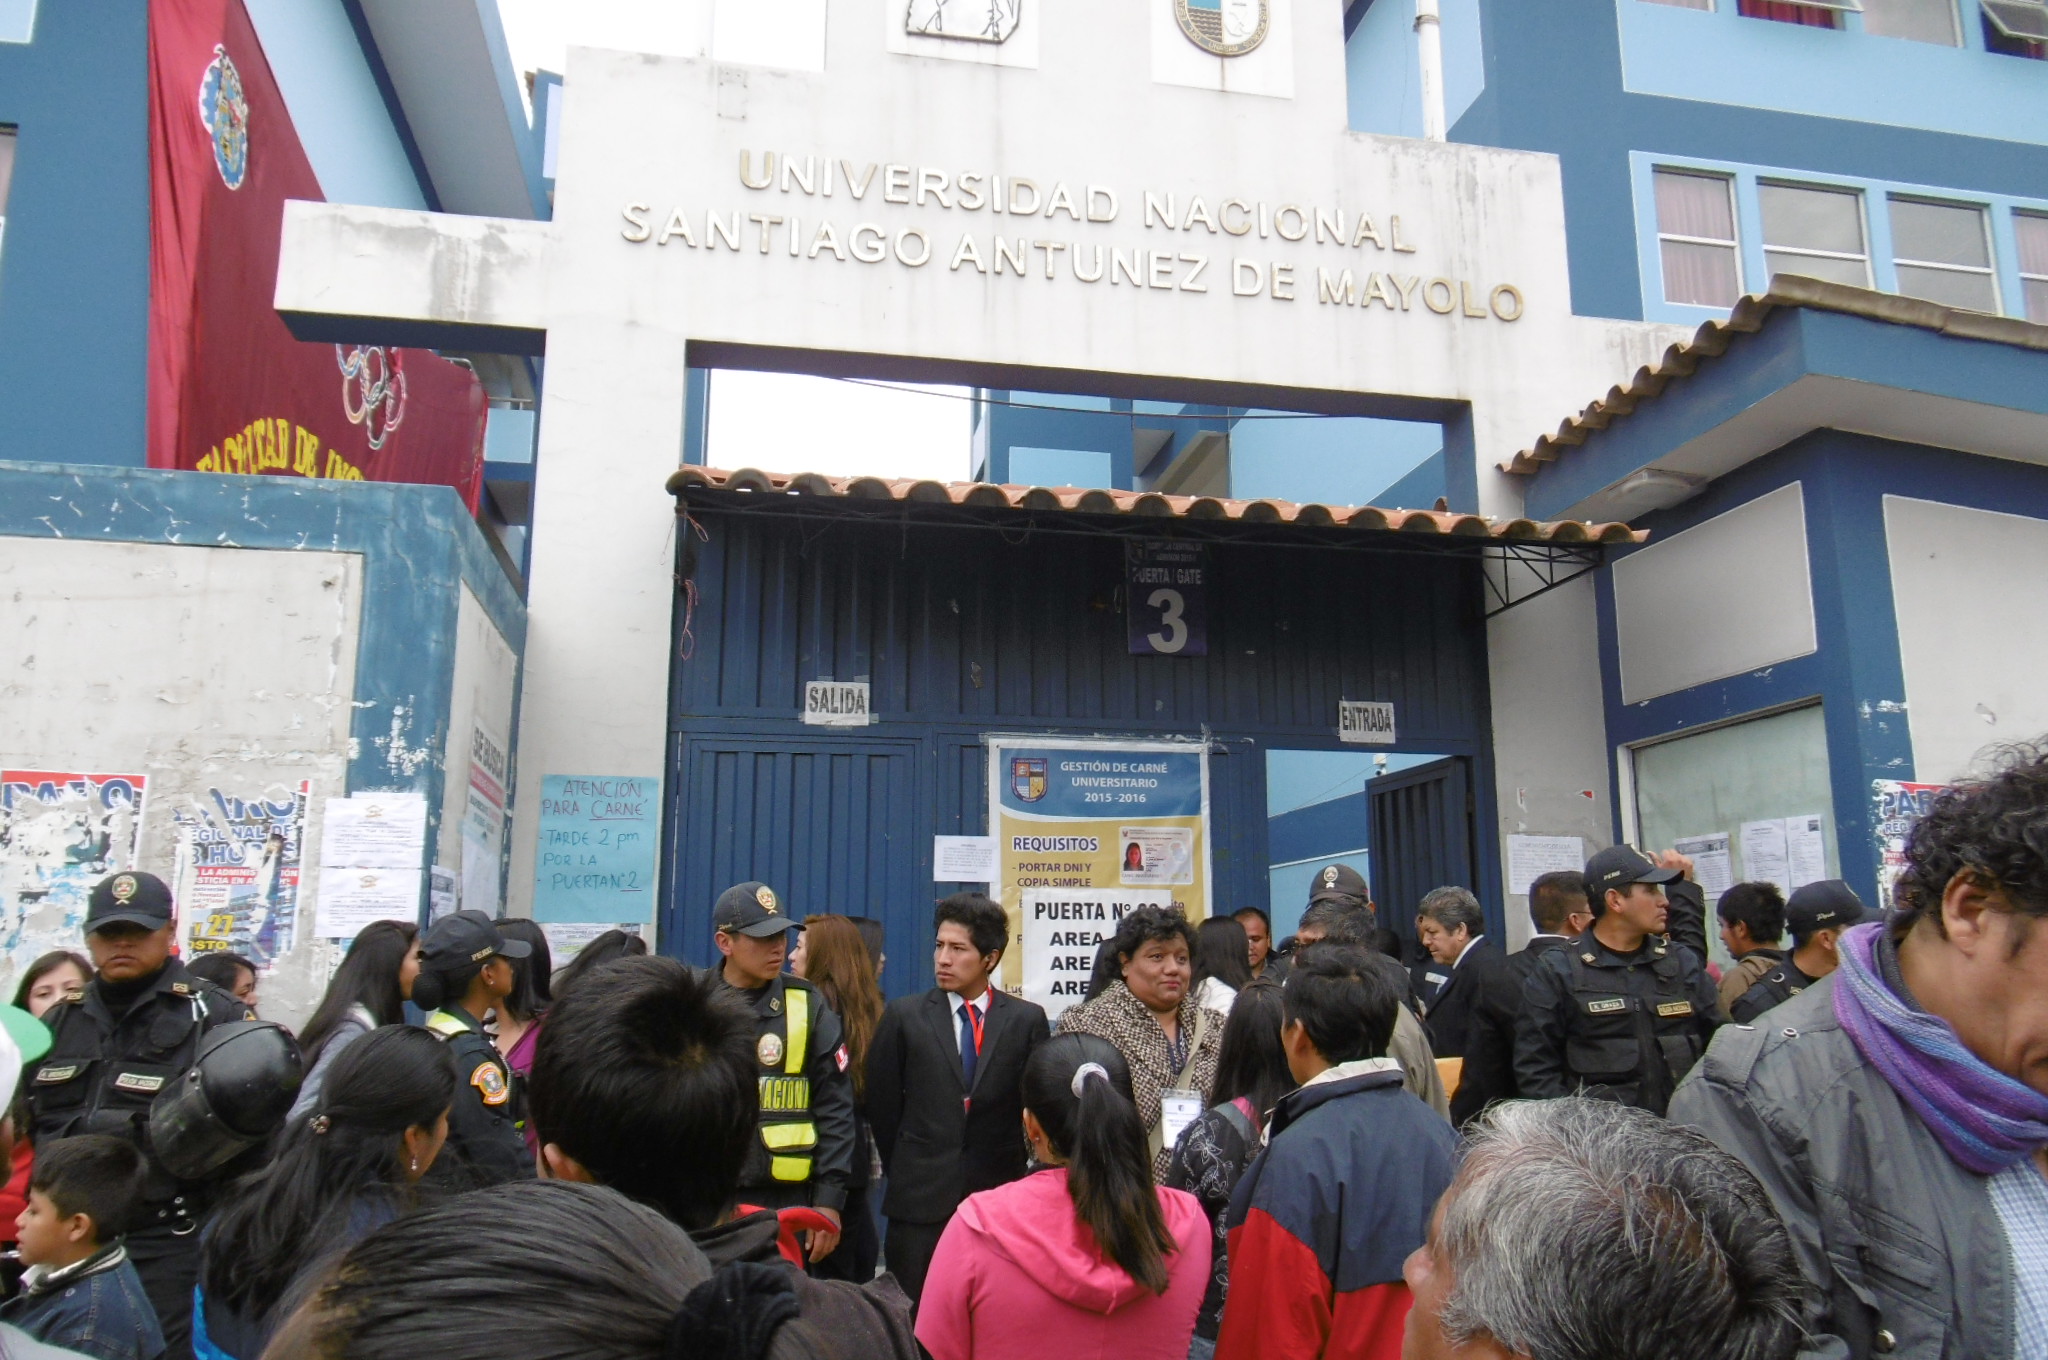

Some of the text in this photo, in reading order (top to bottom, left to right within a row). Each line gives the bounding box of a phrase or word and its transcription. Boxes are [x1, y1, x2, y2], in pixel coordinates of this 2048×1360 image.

[739, 148, 1417, 254] UNIVERSIDAD NACIONAL
[620, 201, 1525, 322] SANTIAGO ANTUNEZ DE MAYOLO
[293, 425, 319, 478] DE
[1132, 567, 1170, 584] PUERTA
[1177, 568, 1202, 584] GATE
[1146, 588, 1188, 653] 3
[809, 686, 866, 715] SALIDA
[1341, 706, 1392, 732] ENTRADA
[1060, 760, 1168, 774] GESTIÓN DE CARNÉ
[563, 779, 642, 798] ATENCIÓN
[1071, 777, 1158, 789] UNIVERSITARIO
[1084, 793, 1112, 803] 2015
[542, 799, 648, 819] PARA CARNÉ
[546, 829, 590, 846] TARDE
[598, 828, 610, 846] 2
[617, 831, 640, 850] pm
[1013, 837, 1098, 852] REQUISITOS
[543, 852, 597, 866] POR LA
[1018, 862, 1061, 873] PORTAR
[1064, 862, 1084, 873] DNI
[1084, 863, 1092, 873] Y
[627, 870, 639, 888] 2
[1017, 877, 1092, 887] COPIA SIMPLE
[1034, 902, 1105, 920] PUERTA
[207, 914, 235, 937] 27
[1050, 931, 1104, 946] AREA
[1050, 956, 1093, 971] ARE
[1050, 980, 1090, 995] ARE
